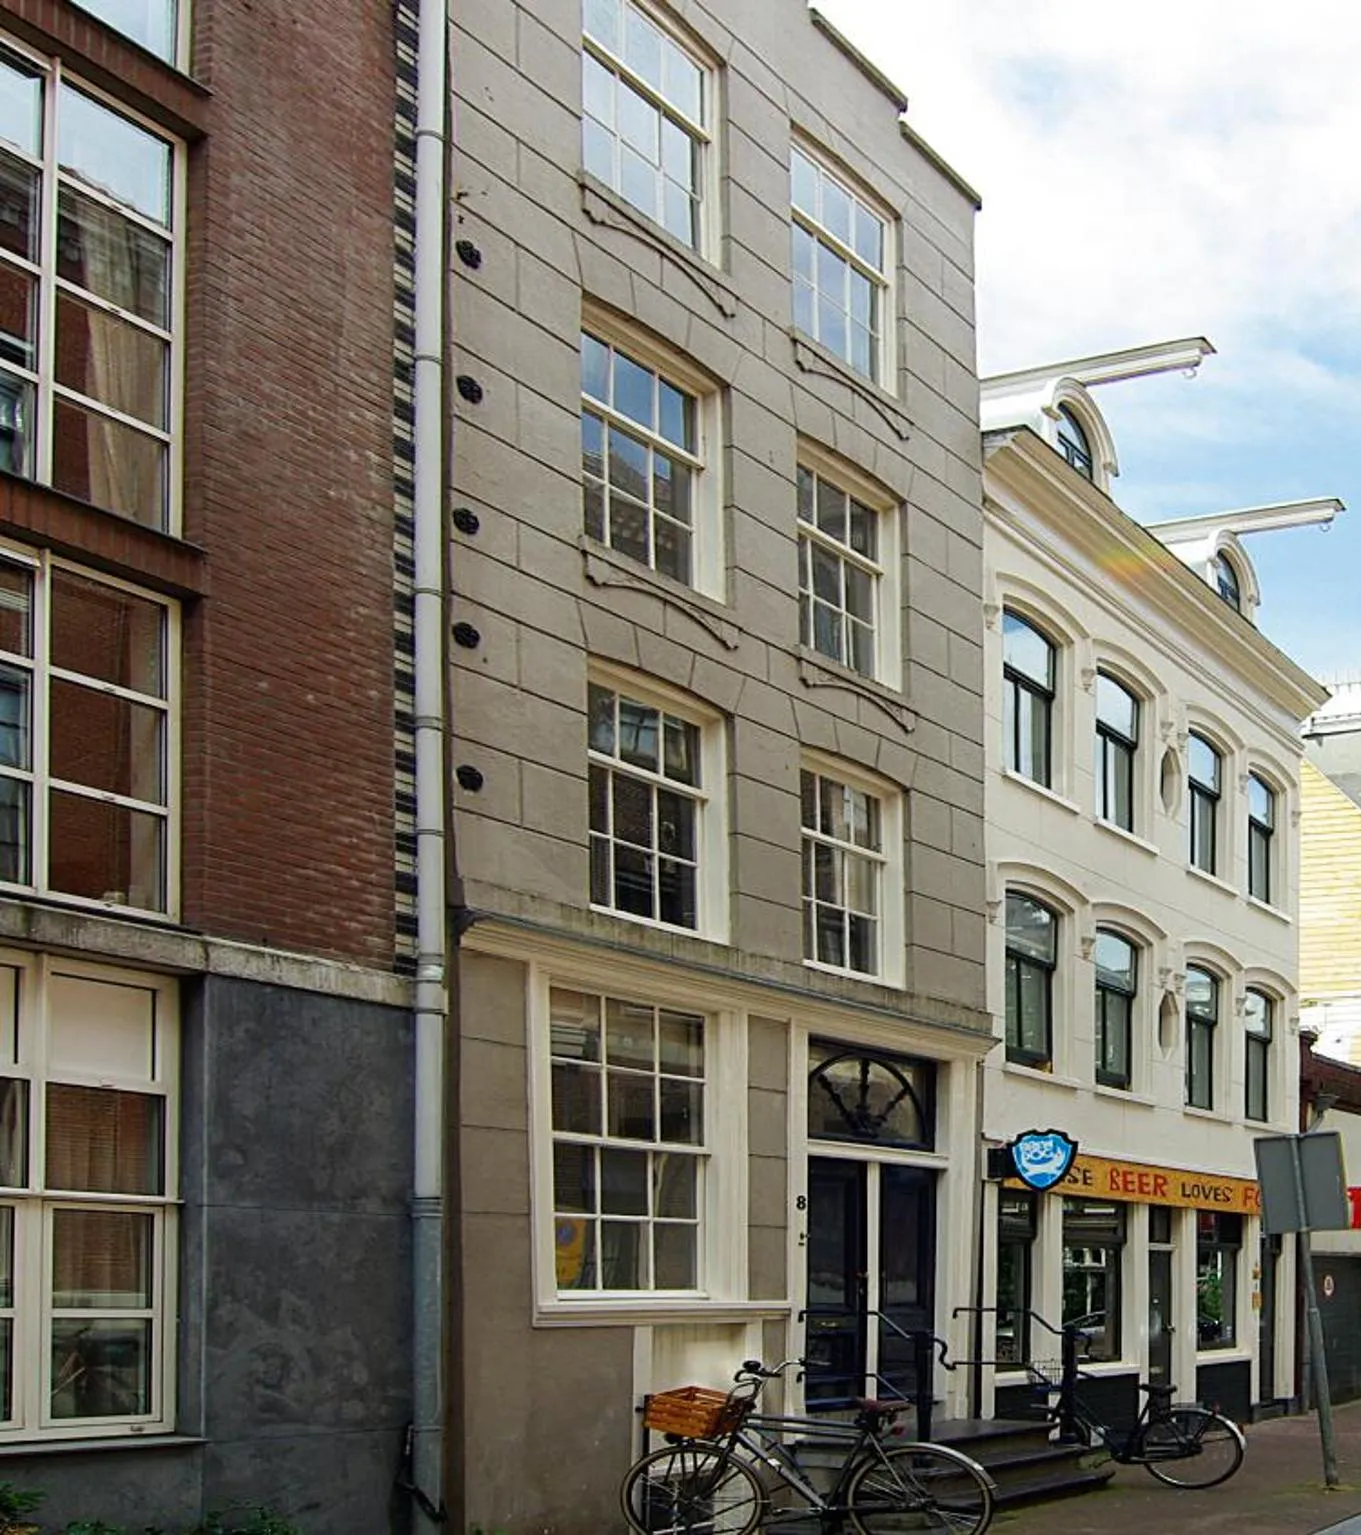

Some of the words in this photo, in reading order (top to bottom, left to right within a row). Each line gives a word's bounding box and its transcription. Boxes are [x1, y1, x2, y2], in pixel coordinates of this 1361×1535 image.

[1108, 1166, 1169, 1198] BEER
[1180, 1181, 1234, 1203] LOVES
[796, 1194, 807, 1211] 8
